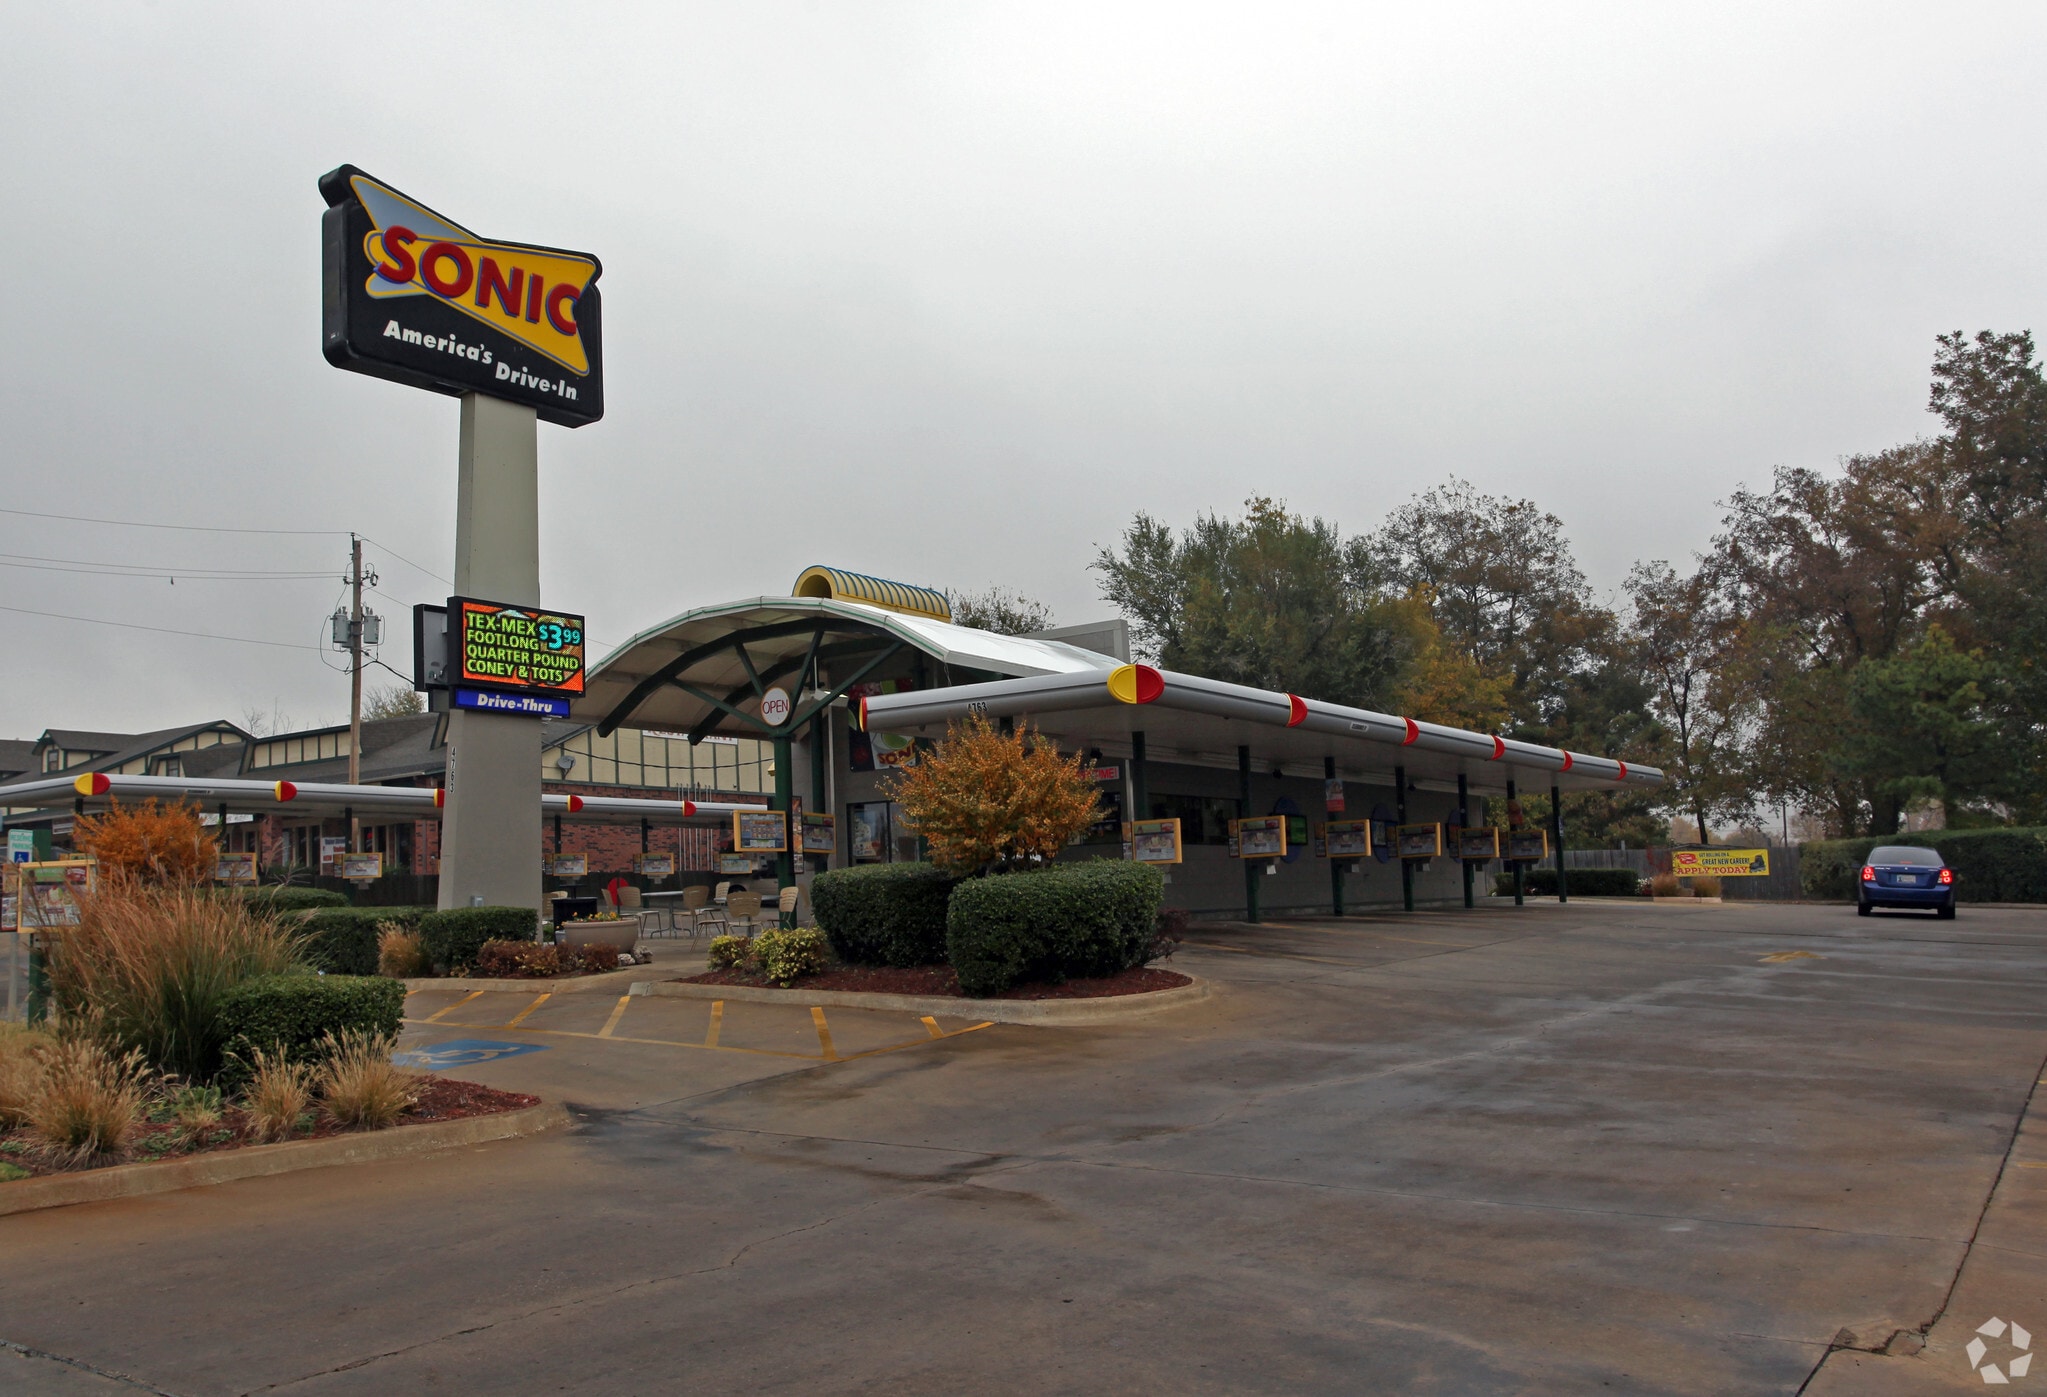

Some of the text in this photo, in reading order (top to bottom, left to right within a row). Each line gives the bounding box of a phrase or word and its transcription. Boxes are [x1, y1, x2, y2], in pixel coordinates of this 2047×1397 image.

[374, 225, 580, 335] SONIC
[383, 320, 493, 365] America's
[466, 612, 536, 636] TEX-MEX
[467, 629, 539, 650] FOOTLONG
[467, 644, 579, 670] QUARTER POUND
[467, 659, 563, 682] CONEY & TOTS
[477, 693, 553, 713] Drive-Thru
[762, 700, 789, 715] OPEN
[1677, 866, 1748, 875] APPLY TODAY
